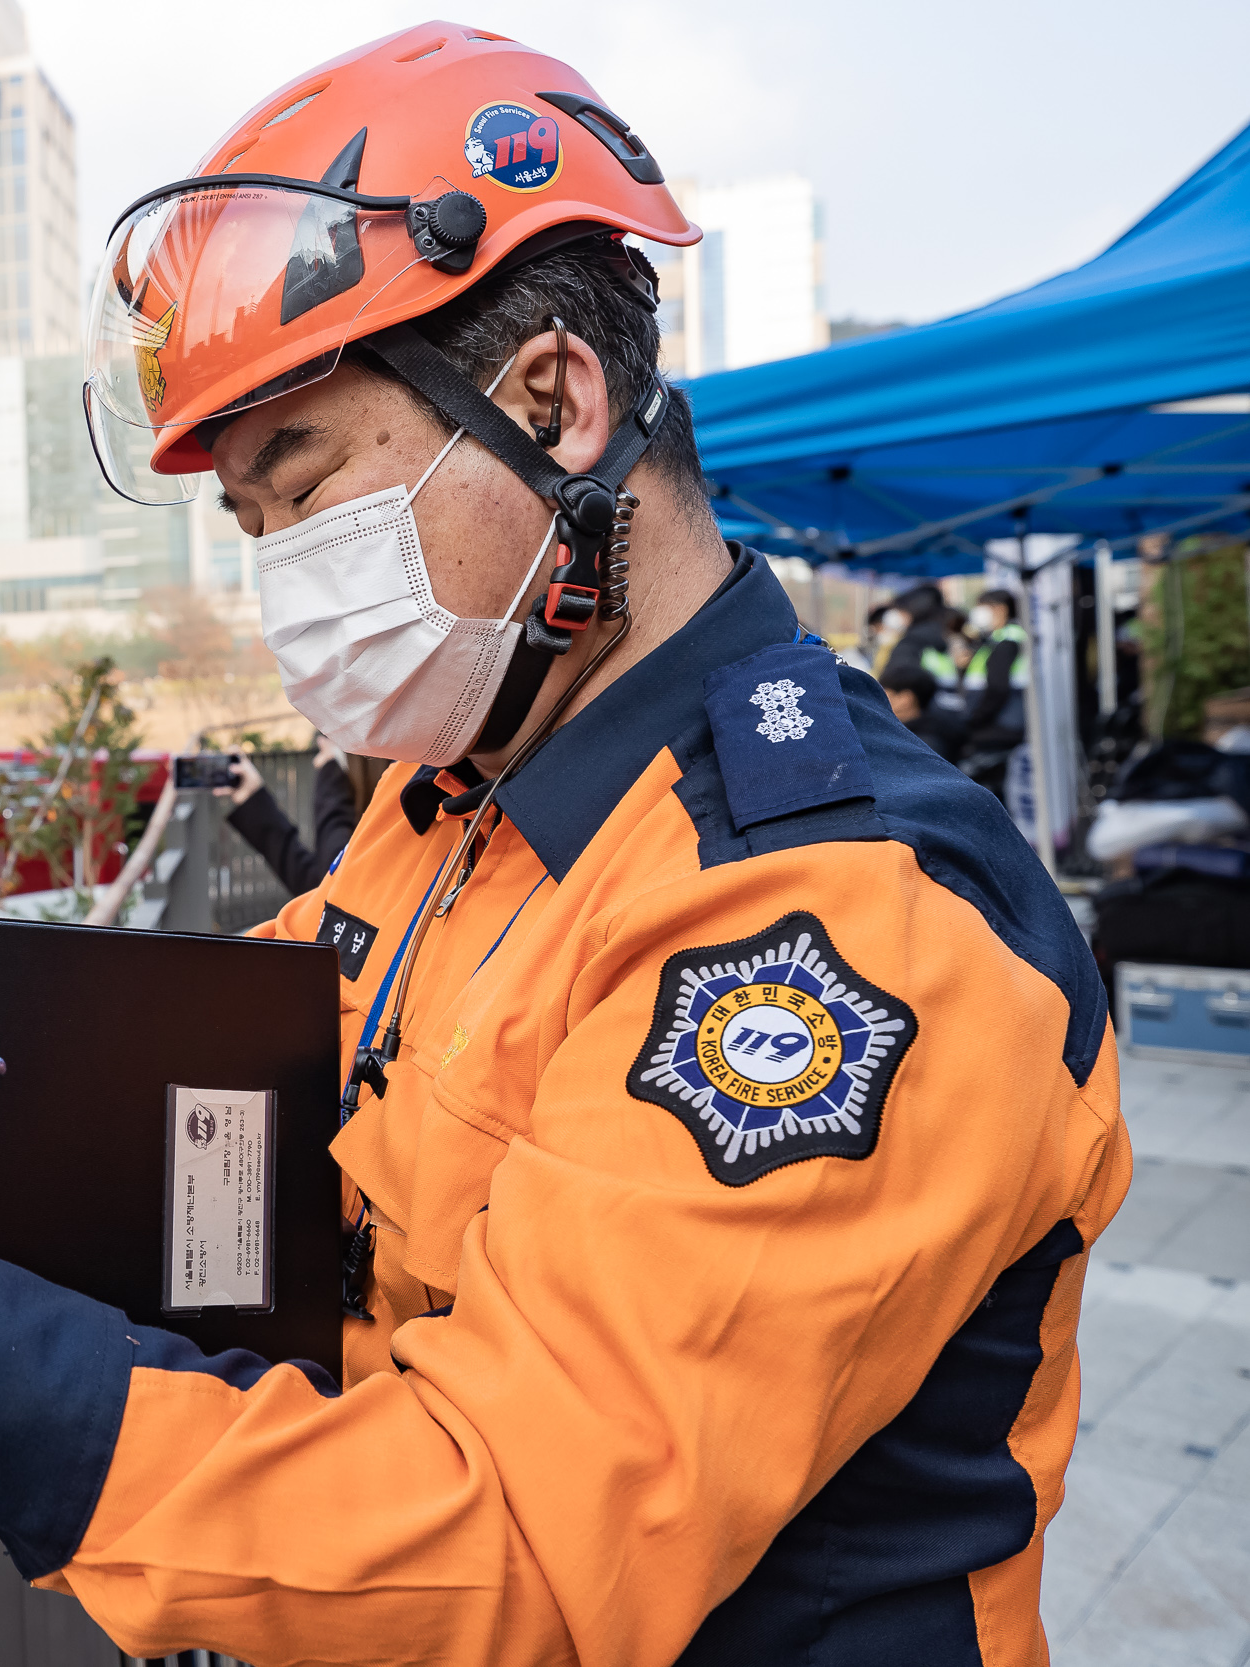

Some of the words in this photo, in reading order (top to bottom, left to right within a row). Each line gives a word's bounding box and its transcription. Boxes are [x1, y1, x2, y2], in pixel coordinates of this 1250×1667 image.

[474, 118, 488, 133] Seoul
[485, 109, 499, 118] Fire
[499, 107, 530, 119] Services
[494, 117, 557, 169] 119
[515, 166, 547, 183] 서울소방
[461, 688, 477, 709] Made
[473, 678, 482, 686] in
[478, 650, 494, 676] Korea
[333, 921, 346, 943] 영
[351, 931, 366, 954] 남
[726, 1026, 810, 1063] 119
[700, 1040, 729, 1083] KOREA
[727, 1076, 760, 1102] FIRE
[766, 1066, 828, 1104] SERVICE
[195, 1103, 211, 1139] 119
[186, 1174, 195, 1235] 소방재난본부
[185, 1239, 194, 1290] 서울특별시
[199, 1240, 207, 1287] 광진소방서
